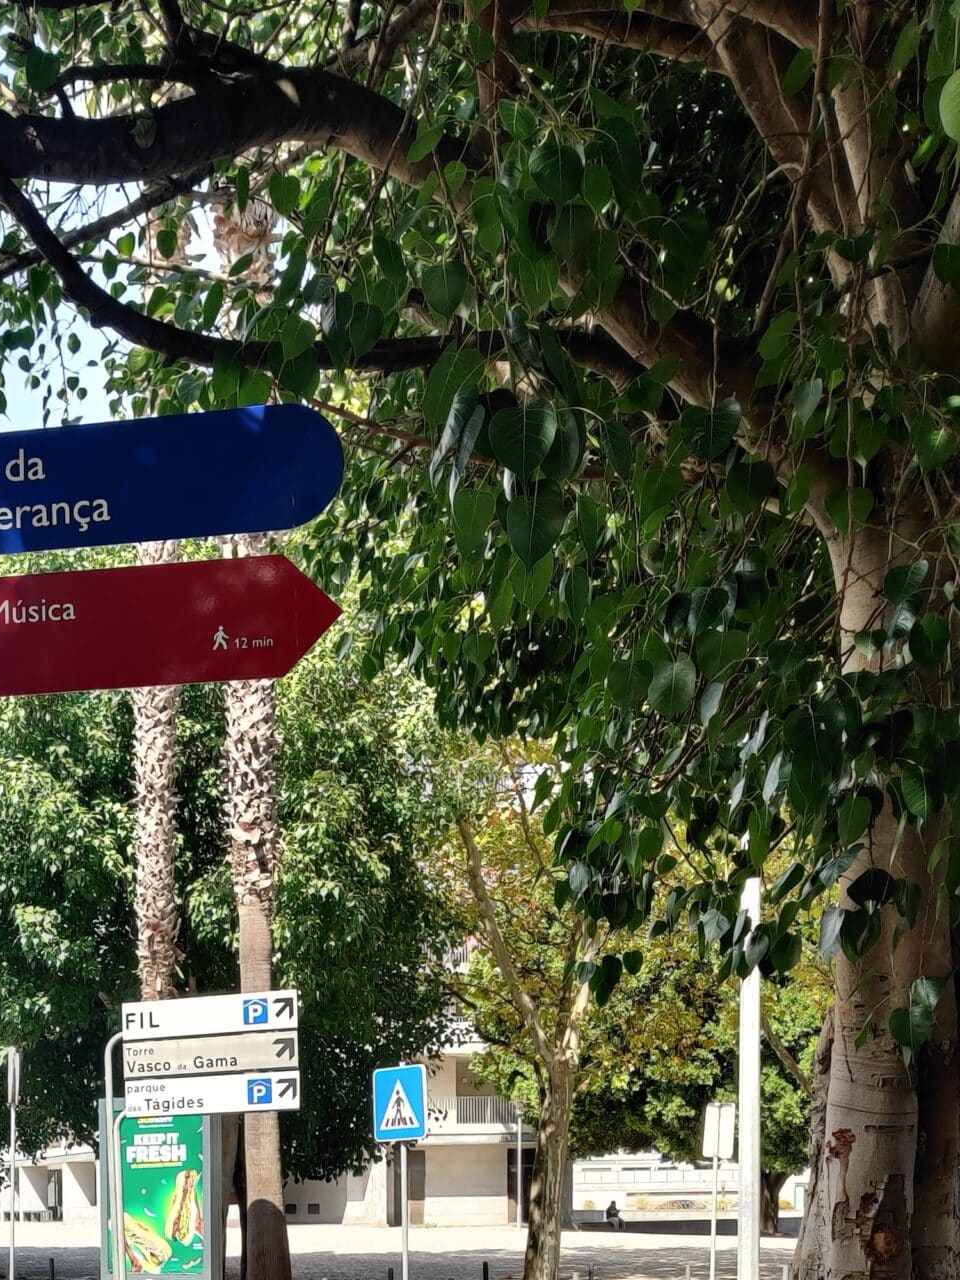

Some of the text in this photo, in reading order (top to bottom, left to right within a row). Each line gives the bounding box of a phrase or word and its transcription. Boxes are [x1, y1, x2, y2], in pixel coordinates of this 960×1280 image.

[5, 449, 46, 483] da
[235, 636, 274, 649] 12 min
[125, 1011, 160, 1030] FIL
[126, 1047, 155, 1057] Torre
[127, 1056, 238, 1073] Vasco da Gama
[127, 1084, 166, 1094] parque
[128, 1097, 204, 1113] das Tágides
[134, 1132, 179, 1145] KEEP IT
[126, 1144, 187, 1163] FRESH
